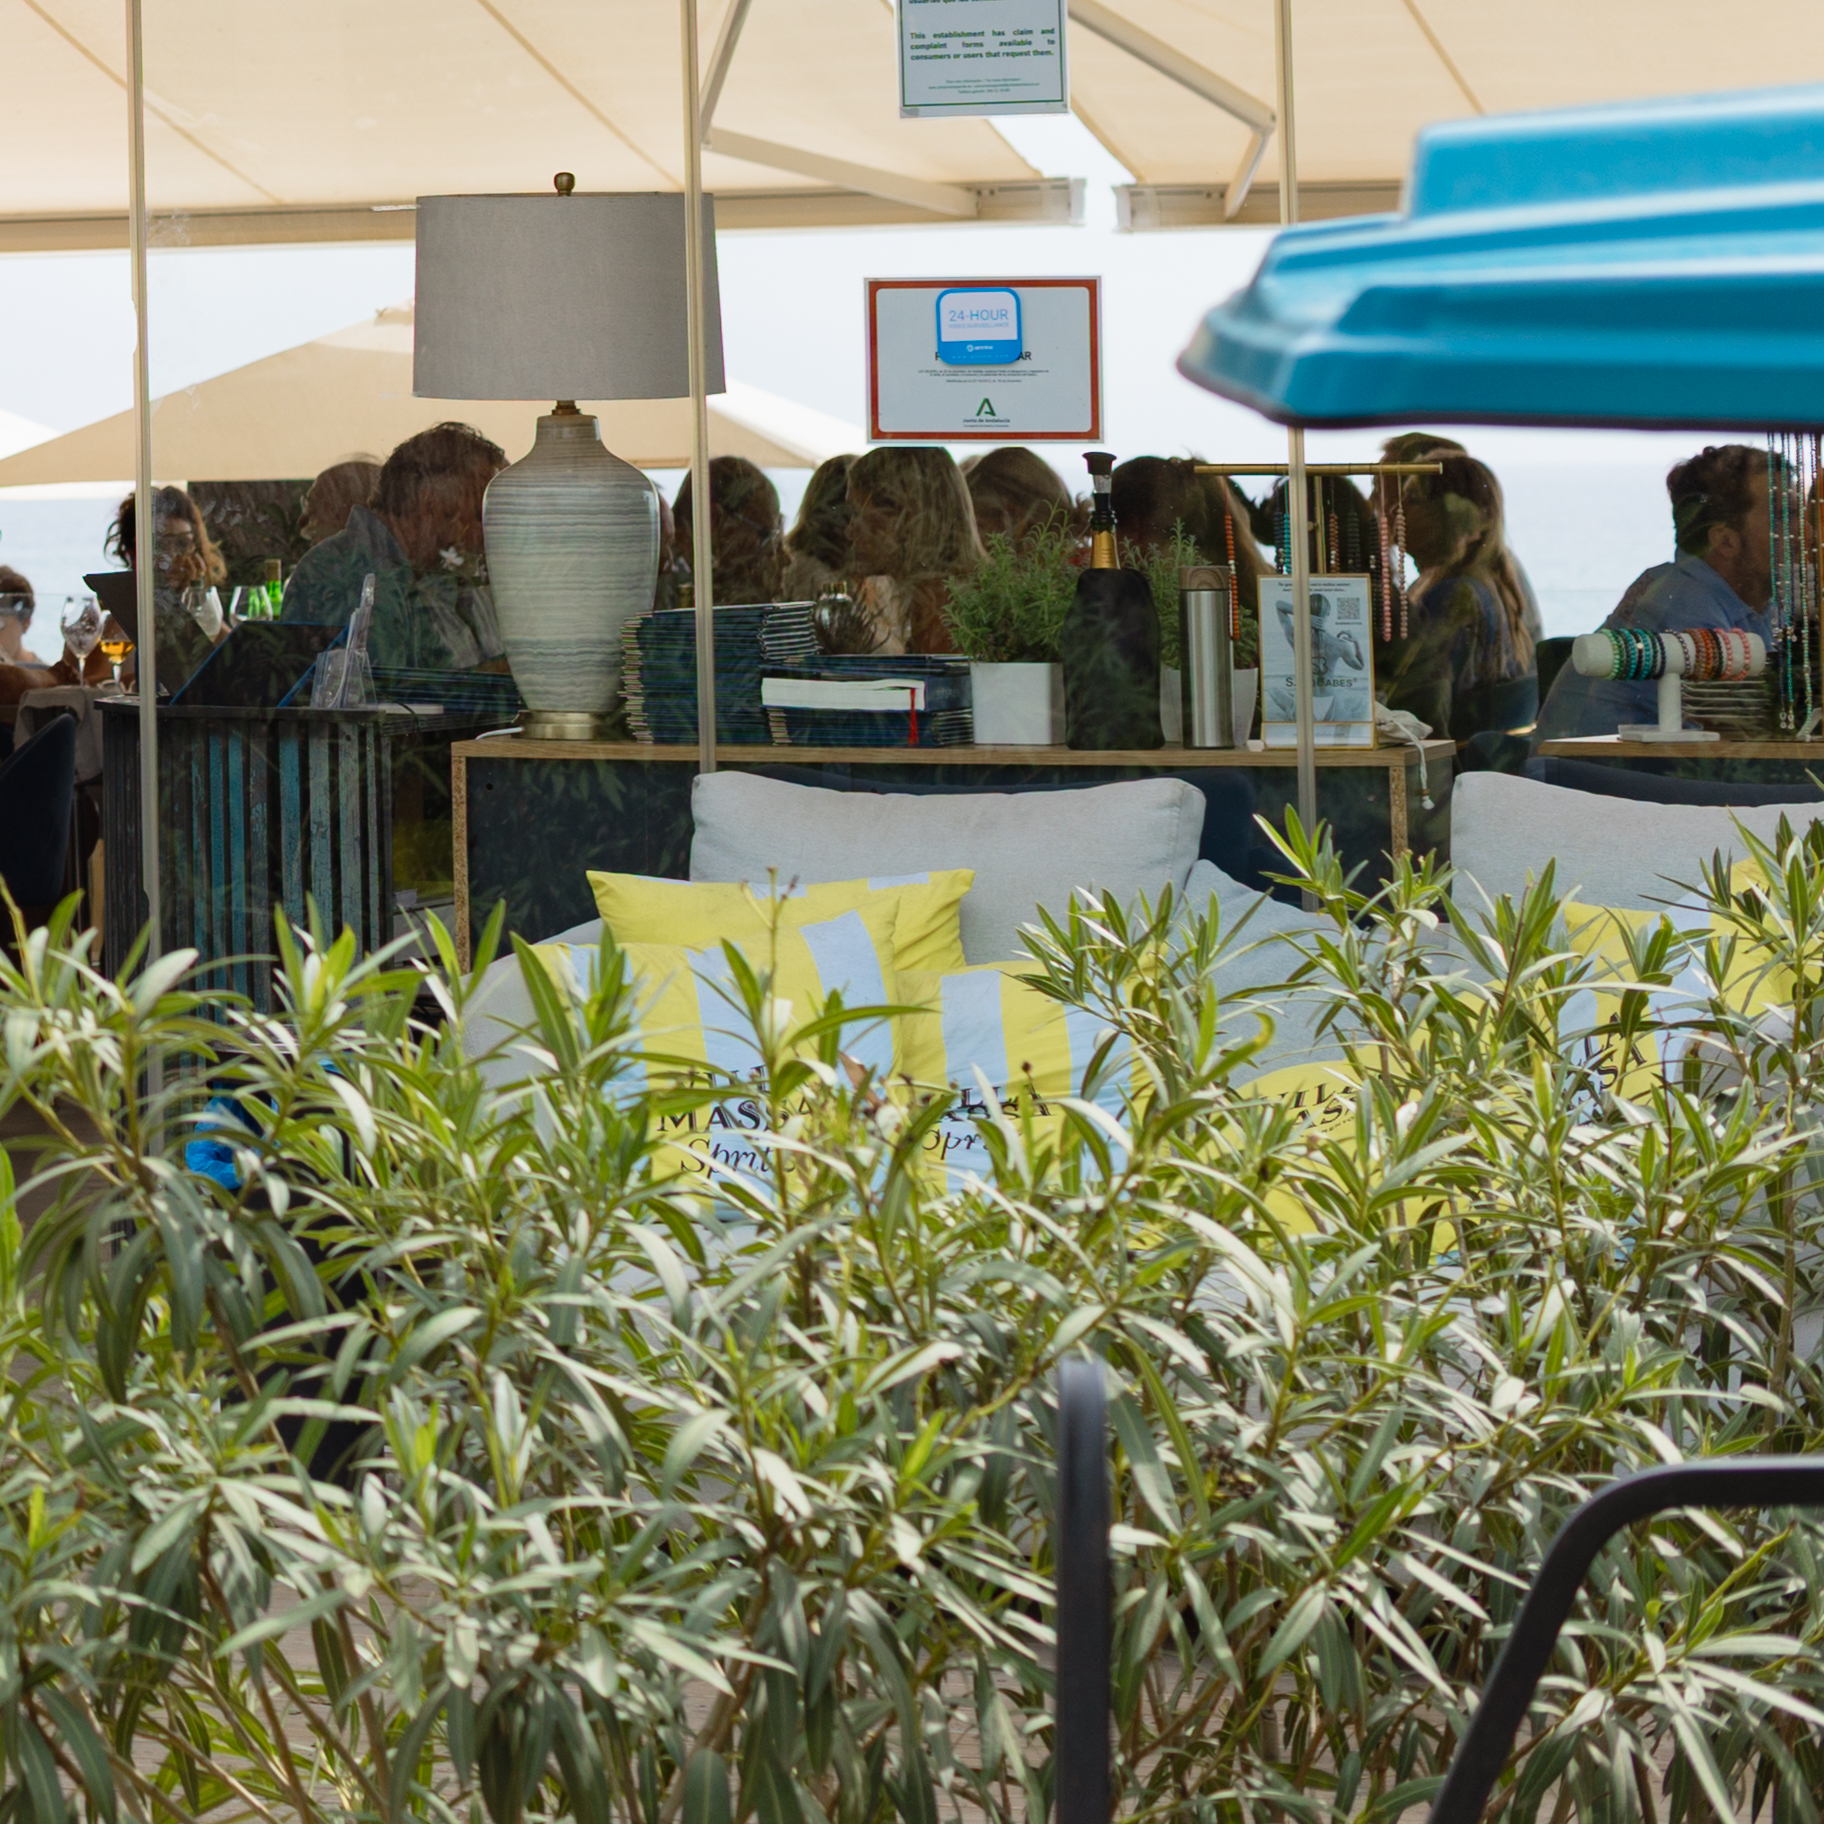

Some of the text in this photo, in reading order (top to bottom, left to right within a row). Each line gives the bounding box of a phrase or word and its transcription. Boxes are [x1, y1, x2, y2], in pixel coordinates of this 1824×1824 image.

[933, 30, 985, 38] establishment
[910, 42, 947, 50] complaint
[1002, 50, 1031, 58] request
[948, 308, 1009, 322] 24-HOUR
